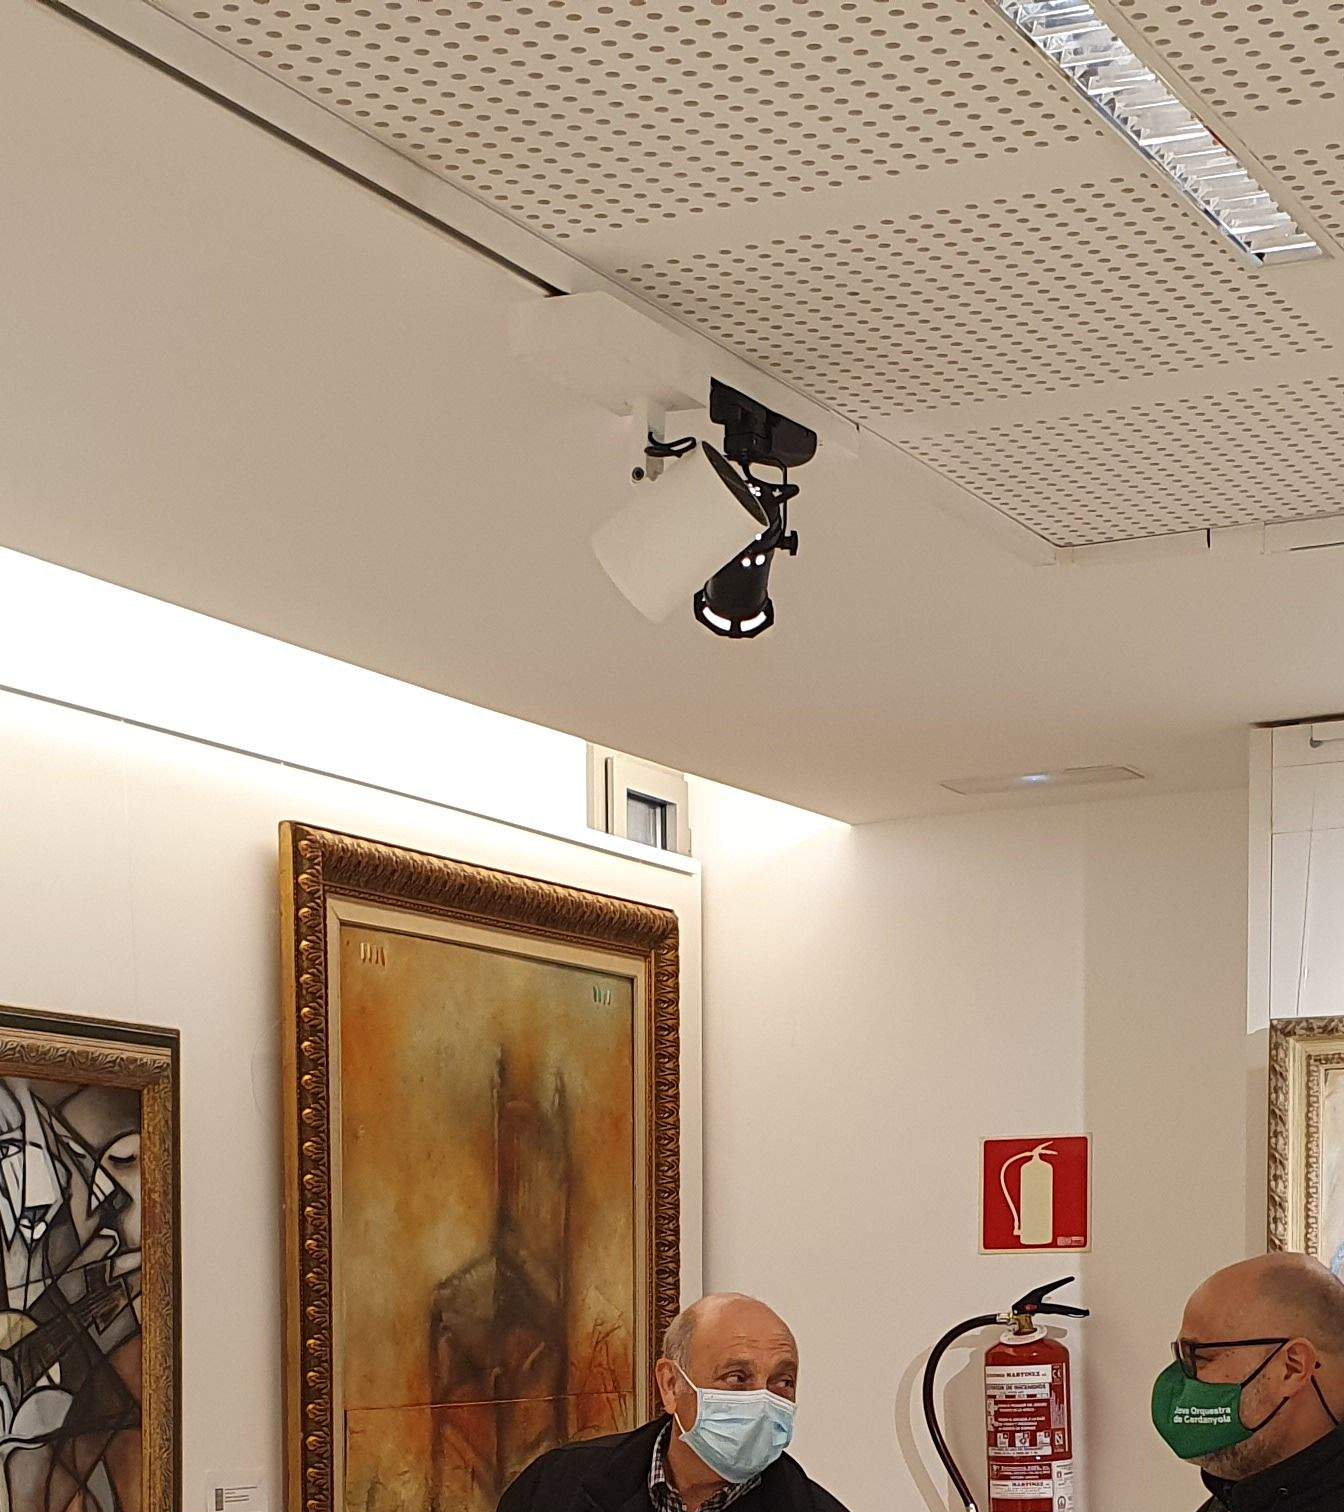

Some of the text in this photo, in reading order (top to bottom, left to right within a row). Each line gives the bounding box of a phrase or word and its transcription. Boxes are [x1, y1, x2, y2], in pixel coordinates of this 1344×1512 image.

[1190, 1406, 1231, 1416] Orquestra
[1173, 1414, 1231, 1425] de Cerdanyola
